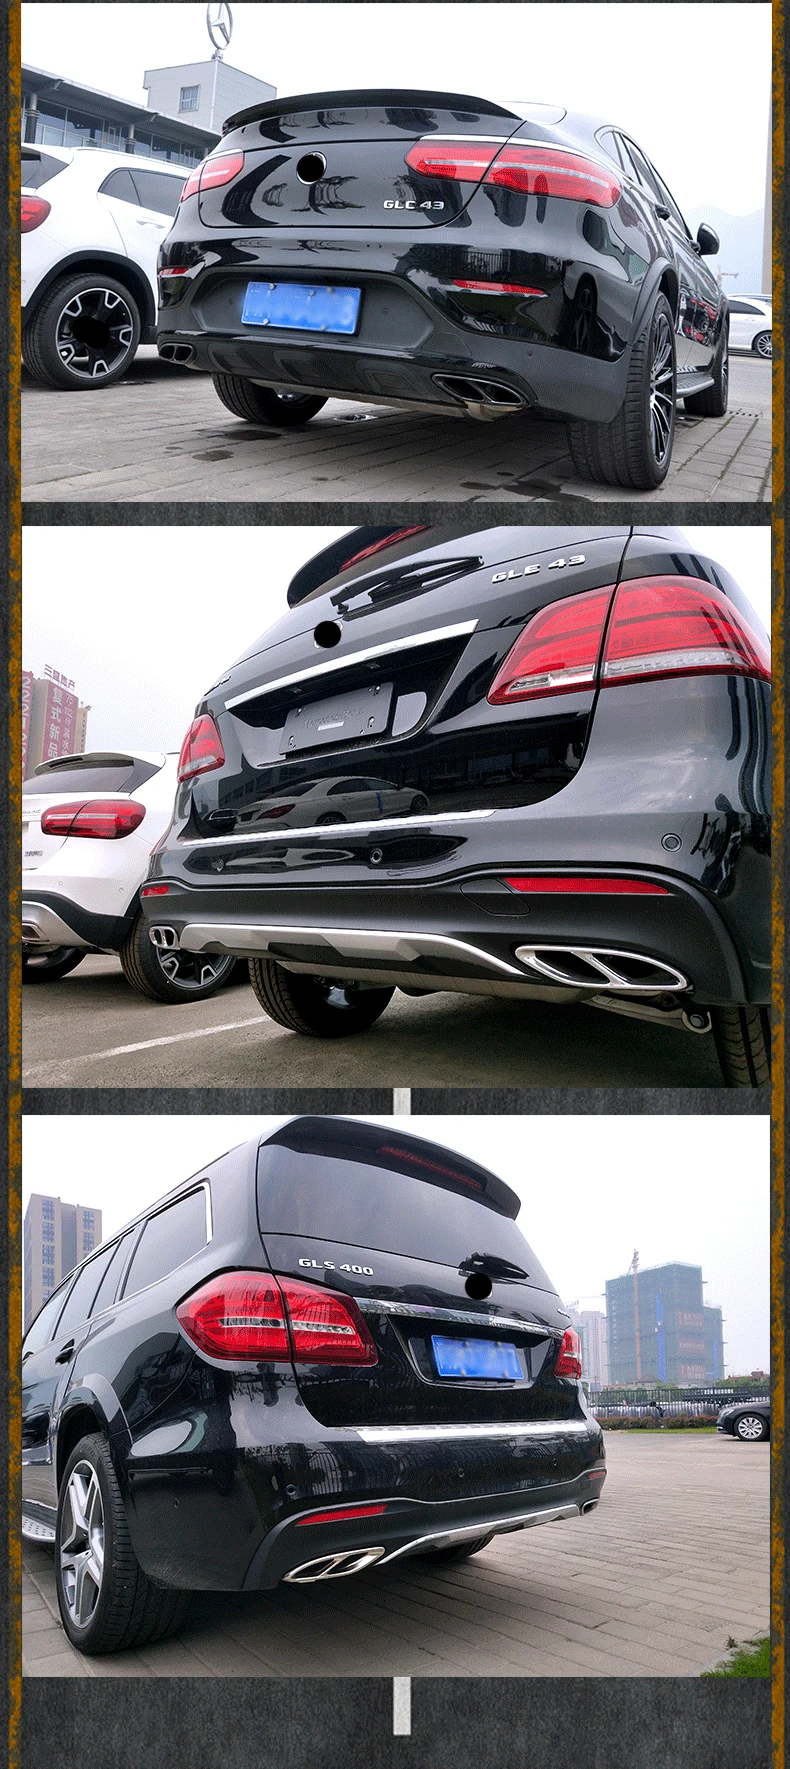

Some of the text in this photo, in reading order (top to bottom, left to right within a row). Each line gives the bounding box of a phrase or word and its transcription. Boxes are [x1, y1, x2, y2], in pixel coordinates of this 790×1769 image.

[383, 199, 445, 210] GLC 43
[491, 554, 586, 584] GLE 43
[298, 1258, 374, 1276] GLS 400
